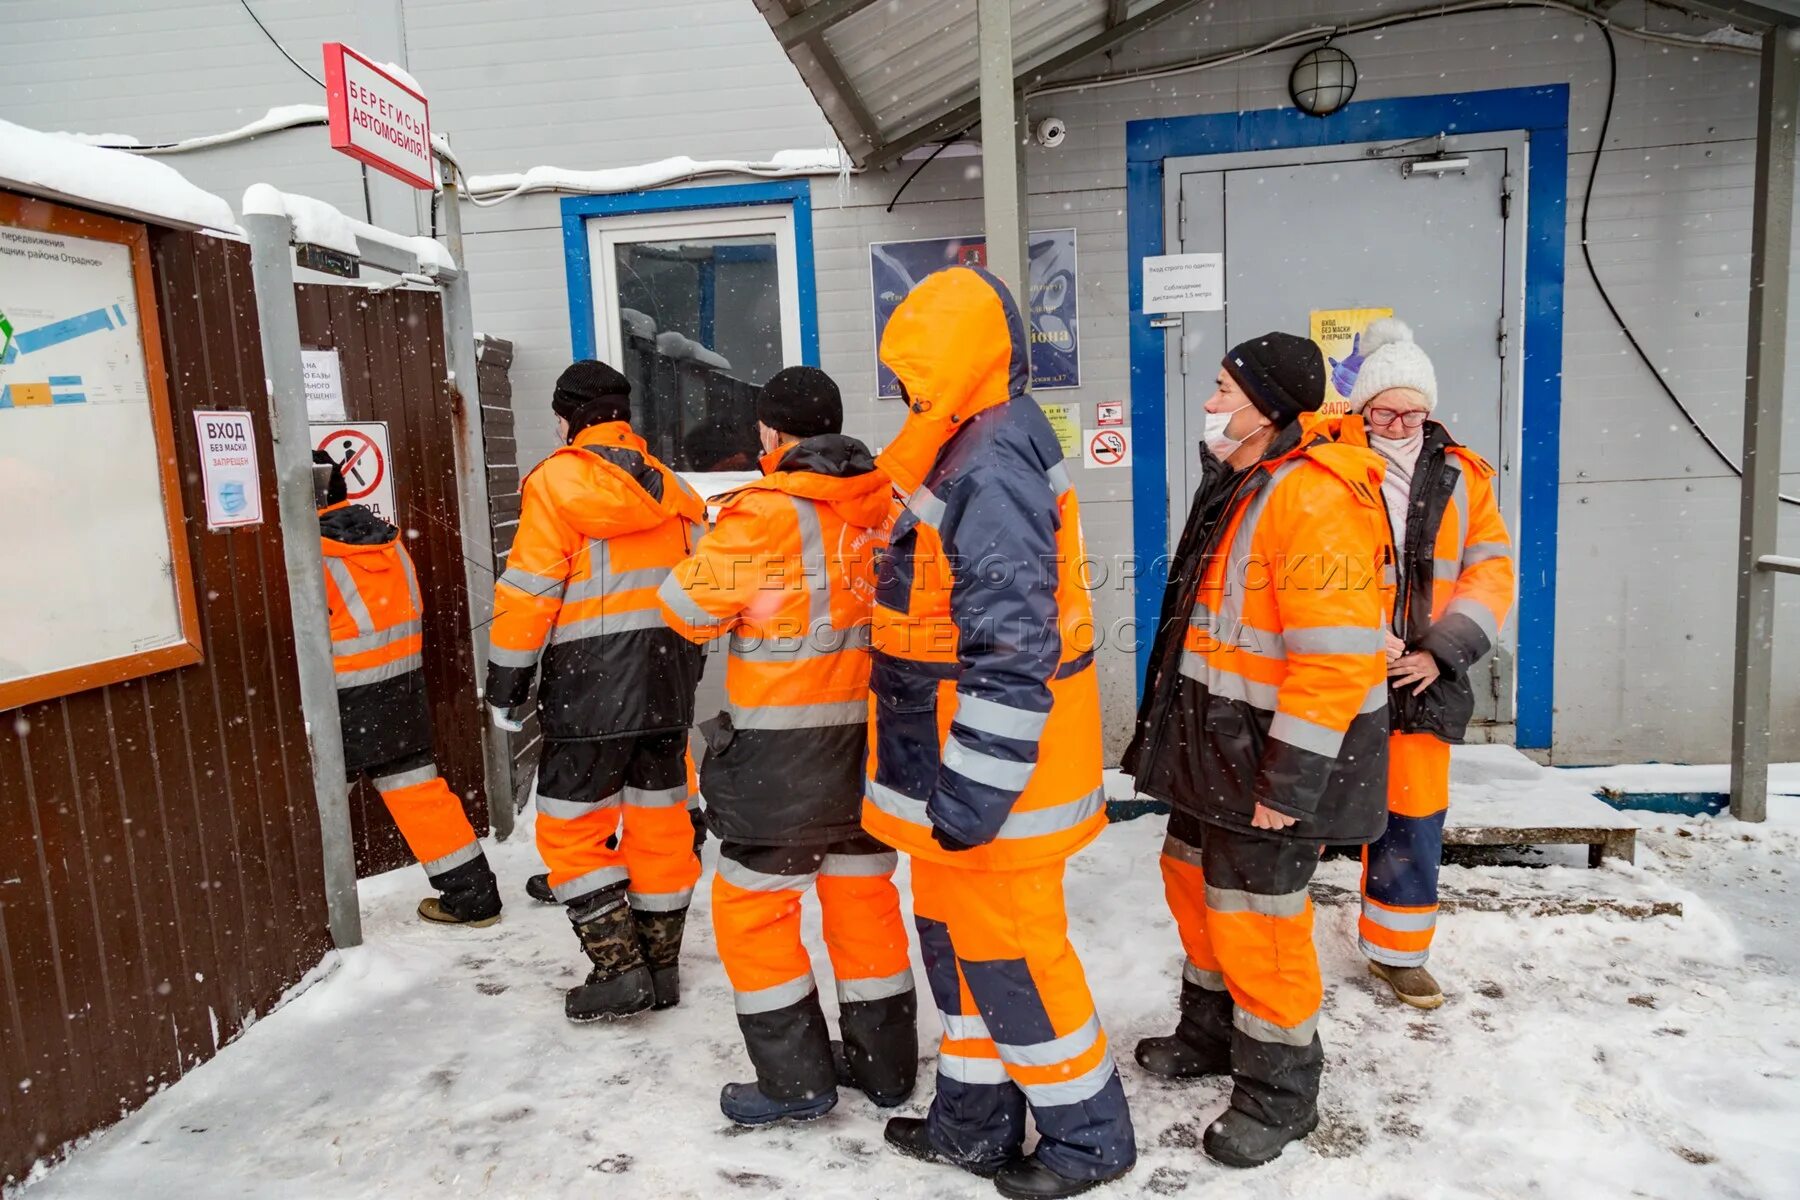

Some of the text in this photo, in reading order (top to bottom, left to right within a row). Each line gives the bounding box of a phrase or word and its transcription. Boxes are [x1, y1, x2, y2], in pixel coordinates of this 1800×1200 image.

[350, 80, 420, 135] БЕРЕГИСЬ
[2, 232, 65, 248] передвижения
[28, 250, 59, 262] района
[1164, 264, 1184, 273] строго
[1321, 319, 1336, 327] ВХОД
[1321, 400, 1350, 415] ЗАПР
[207, 422, 245, 442] ВХОД
[210, 443, 248, 452] БЕЗ МАСКИ
[212, 458, 249, 467] ЗАПРЕЩЕН
